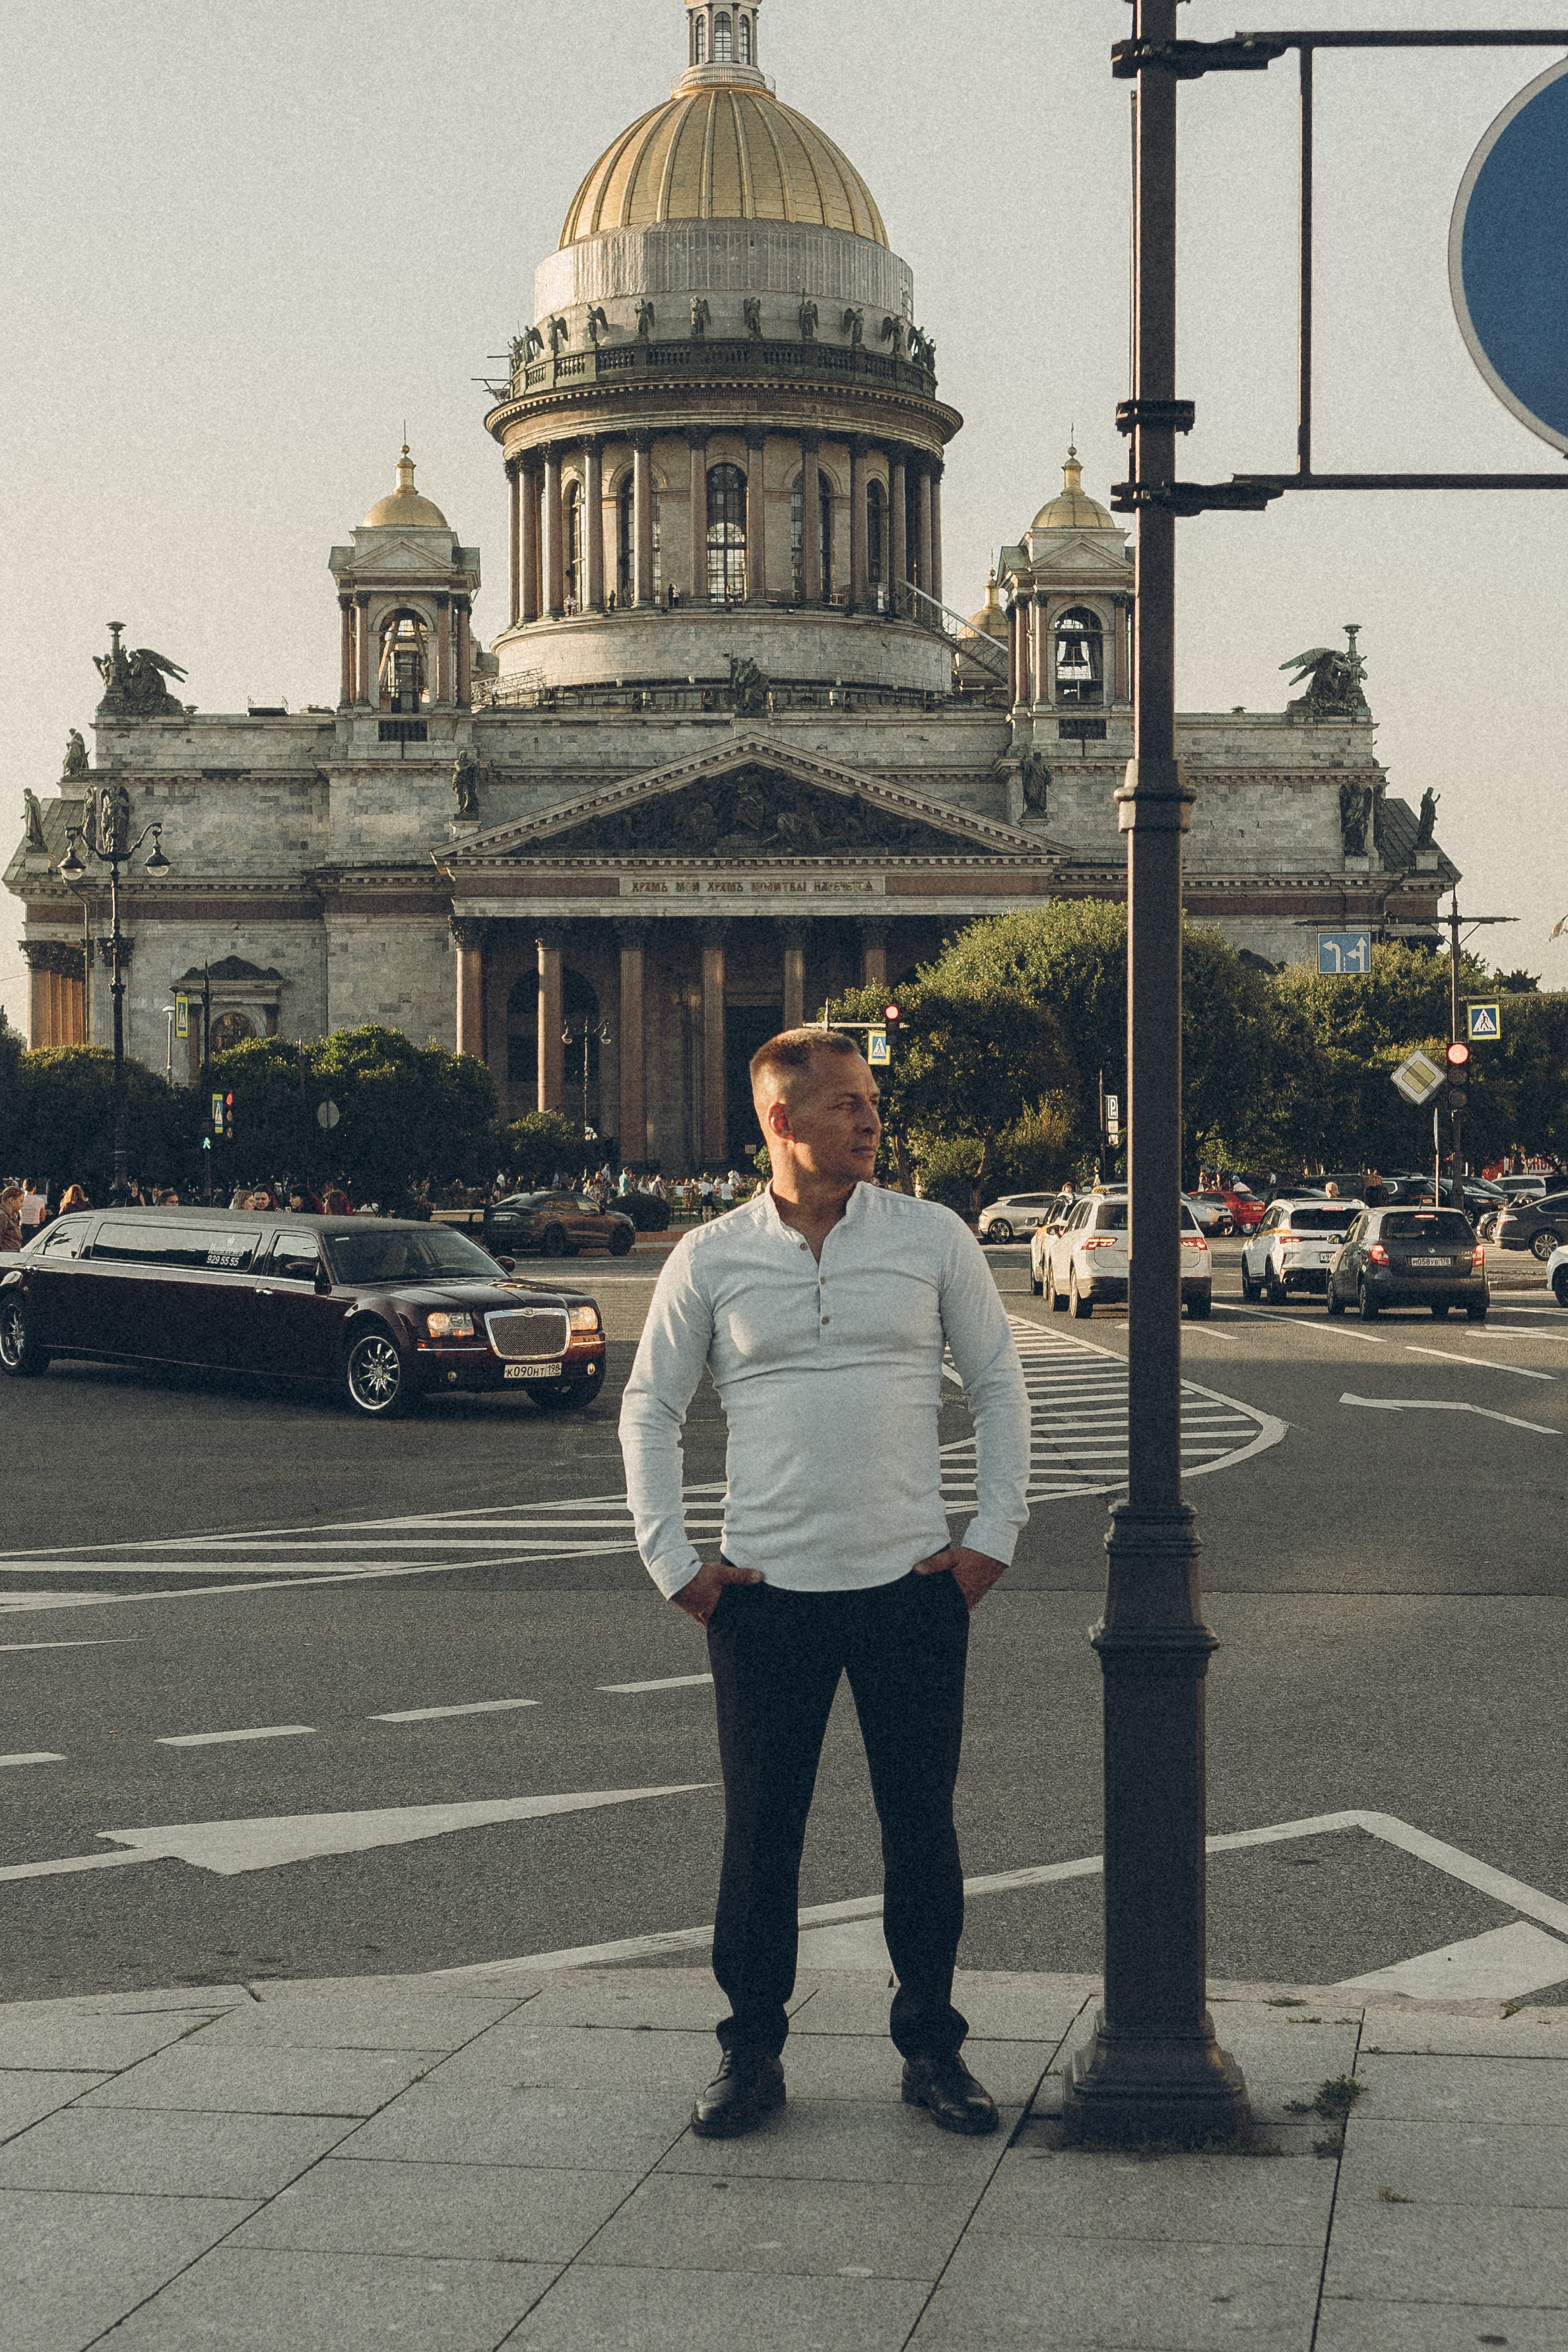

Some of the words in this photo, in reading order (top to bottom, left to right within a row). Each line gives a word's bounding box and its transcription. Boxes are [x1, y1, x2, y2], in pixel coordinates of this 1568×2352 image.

[632, 882, 668, 892] ХРАМЪ
[707, 882, 744, 892] ХРАМЪ
[207, 1255, 220, 1264] 929
[220, 1256, 230, 1265] 55
[229, 1257, 240, 1266] 55
[507, 1366, 545, 1377] К090НТ
[546, 1363, 560, 1373] 198
